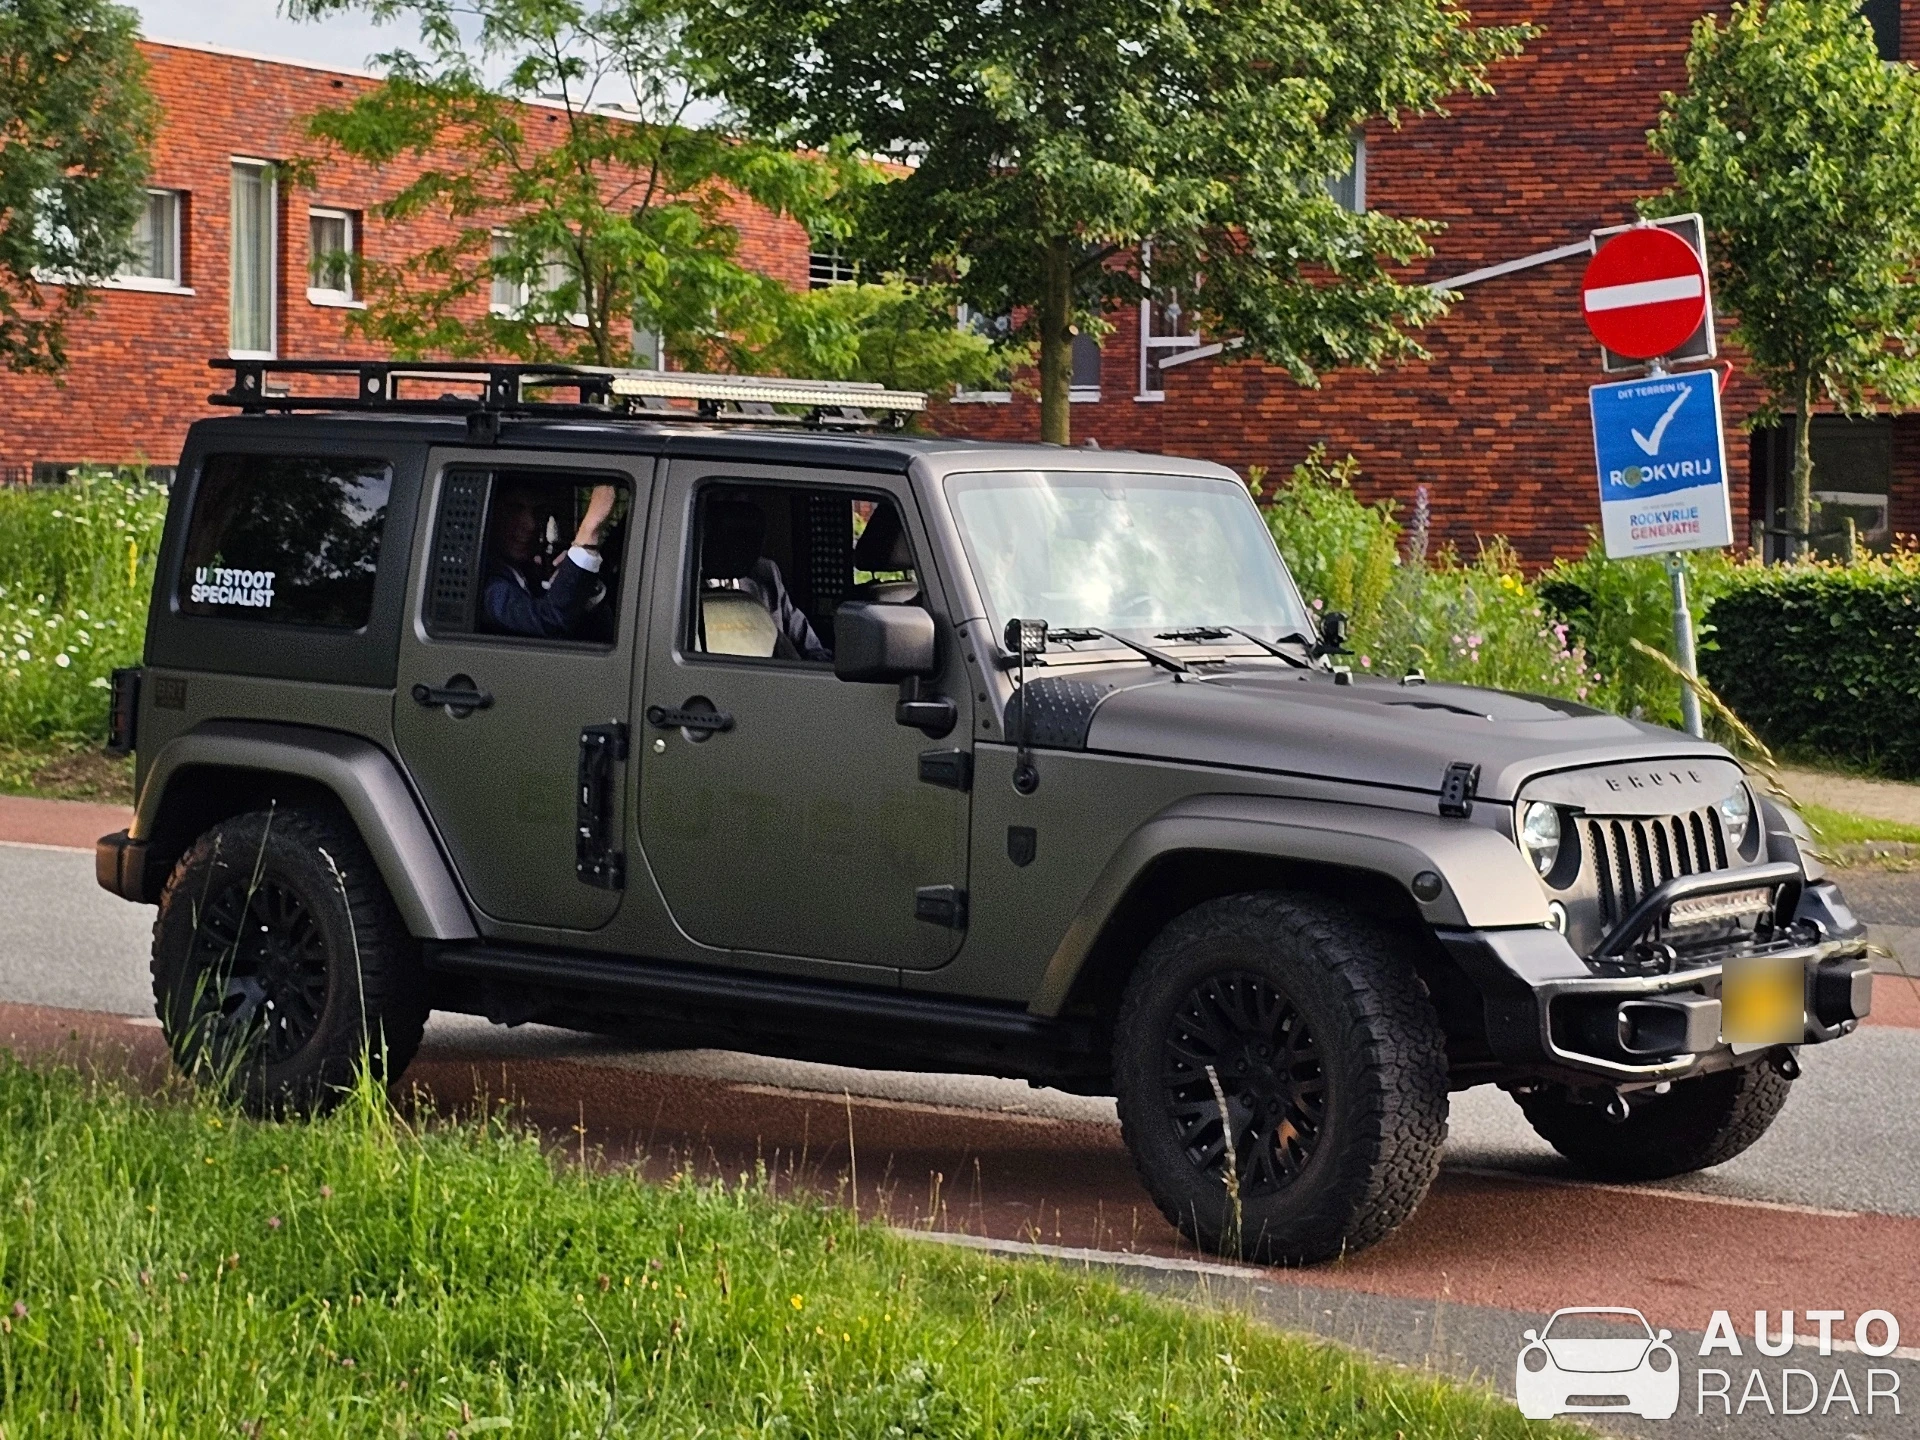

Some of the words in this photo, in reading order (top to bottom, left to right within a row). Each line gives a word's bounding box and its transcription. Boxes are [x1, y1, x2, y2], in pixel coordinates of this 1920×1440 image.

[1617, 390, 1634, 400] DIT
[1636, 384, 1677, 397] TERREIN
[1677, 381, 1687, 392] IS
[1610, 457, 1712, 487] ROKVRIJ
[1630, 507, 1698, 526] ROOKVRIJE
[1631, 521, 1700, 540] GENERATIE
[190, 584, 275, 607] SPECIALIST
